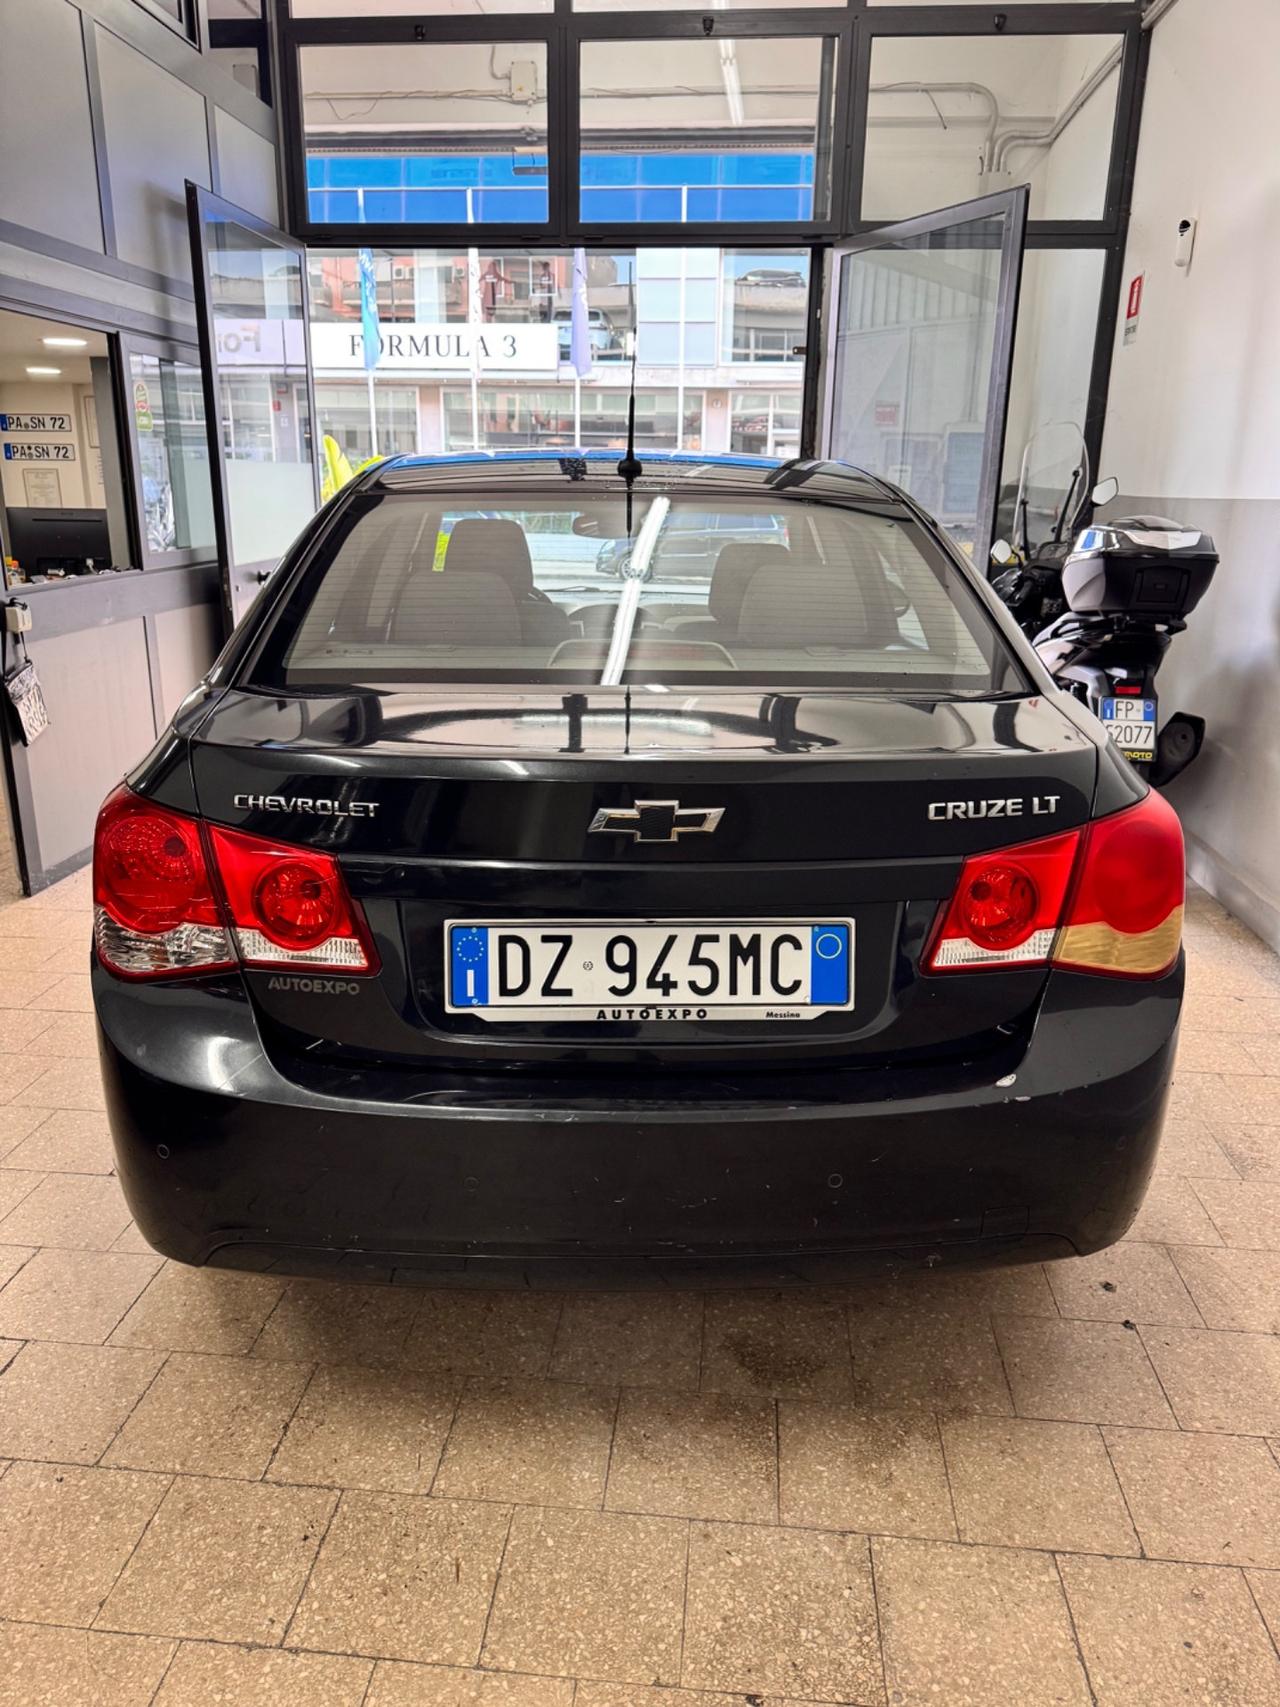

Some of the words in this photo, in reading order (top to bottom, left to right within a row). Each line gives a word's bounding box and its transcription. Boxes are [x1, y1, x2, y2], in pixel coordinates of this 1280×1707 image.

[350, 334, 492, 358] FRMULA
[503, 334, 517, 358] 3
[8, 416, 22, 428] PA
[30, 416, 46, 429] SN
[50, 416, 66, 430] 72
[12, 445, 27, 458] PA
[34, 445, 50, 458] SN
[54, 446, 70, 459] 72
[1115, 701, 1134, 719] FP
[233, 794, 380, 817] CHEVROLET
[928, 798, 1024, 820] CRUZE
[1032, 795, 1061, 815] LT
[498, 934, 574, 997] DZ
[605, 933, 803, 997] 945MC
[268, 976, 361, 995] AUTOEXPO
[596, 1008, 708, 1021] AUTOEXPO
[765, 1010, 801, 1019] Messina
